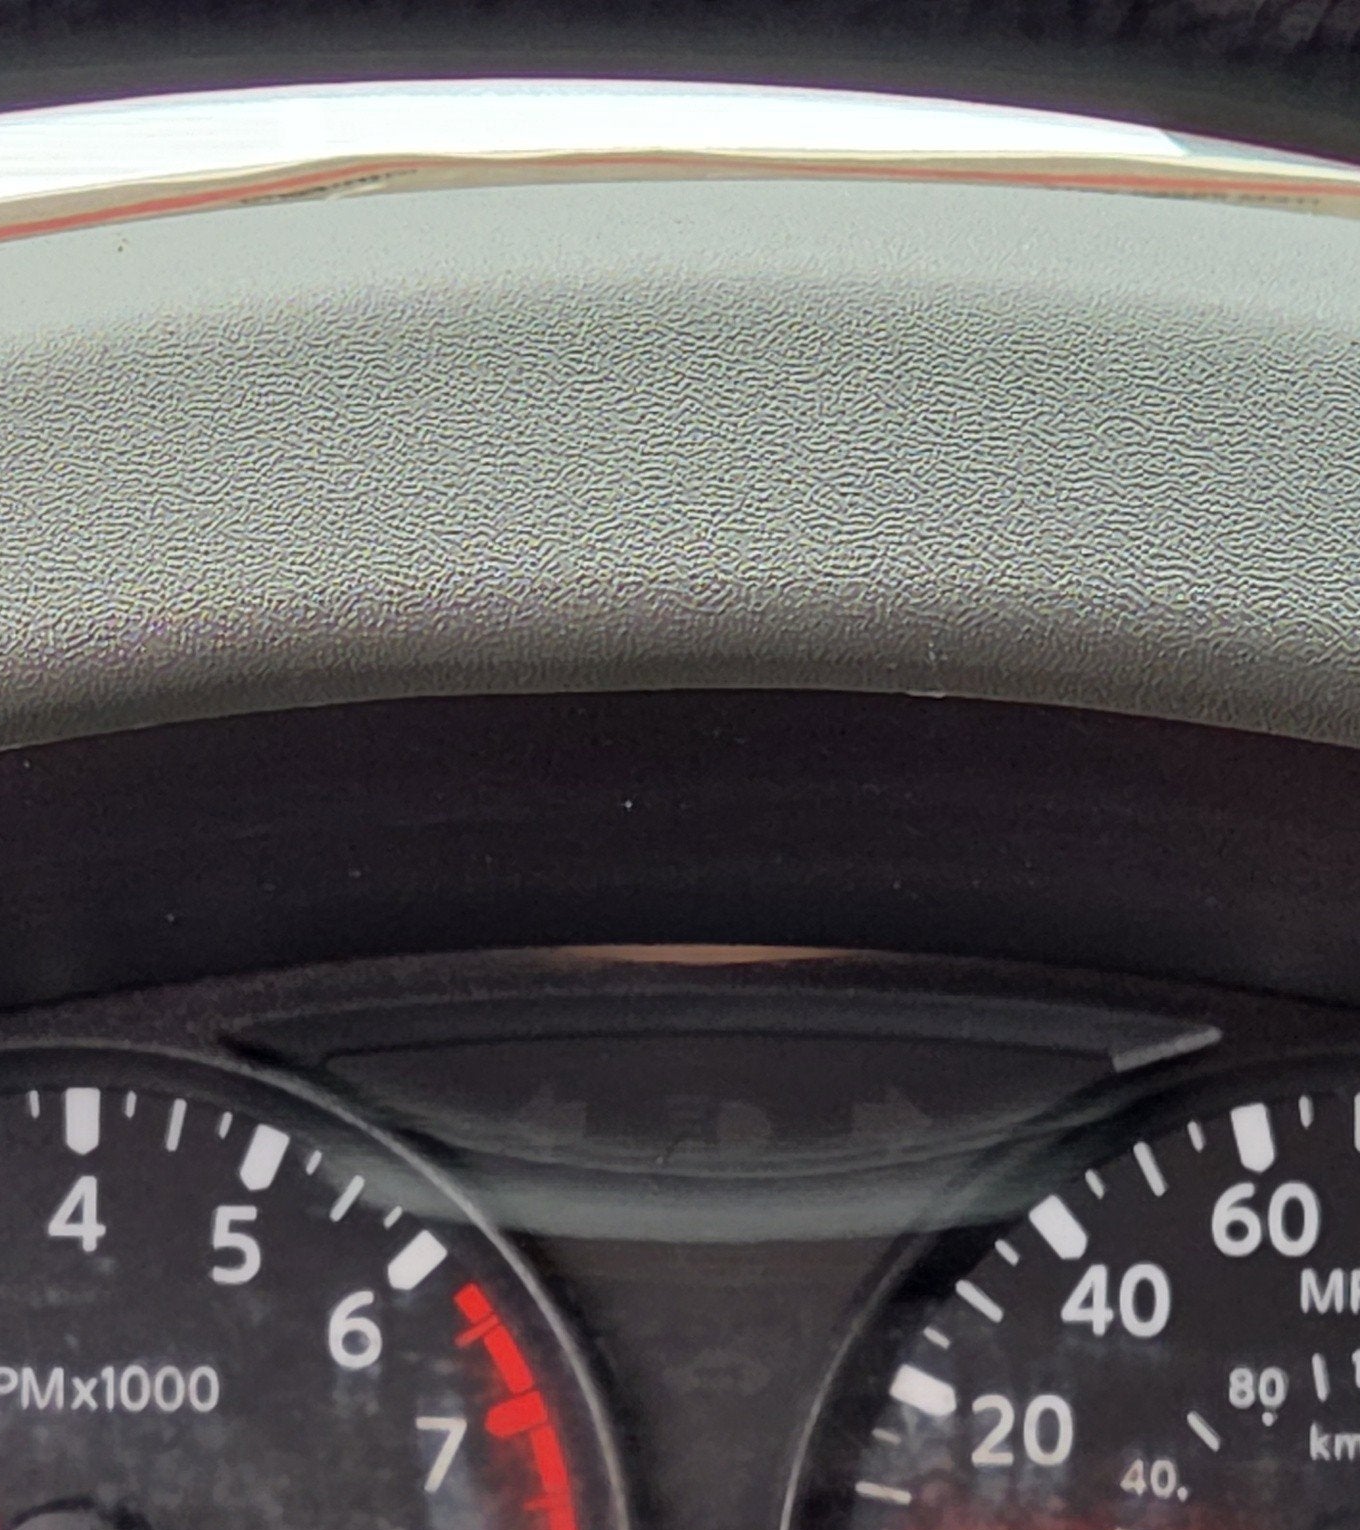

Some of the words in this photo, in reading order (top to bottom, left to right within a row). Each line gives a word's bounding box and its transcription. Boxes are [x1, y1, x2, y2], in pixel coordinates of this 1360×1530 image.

[48, 1176, 106, 1252] 4
[212, 1206, 261, 1284] 5
[1211, 1182, 1320, 1257] 60
[328, 1291, 382, 1370] 6
[1060, 1263, 1171, 1337] 40
[1228, 1367, 1286, 1406] 80
[416, 1416, 468, 1493] 7
[971, 1394, 1074, 1467] 20
[1121, 1458, 1175, 1499] 40
